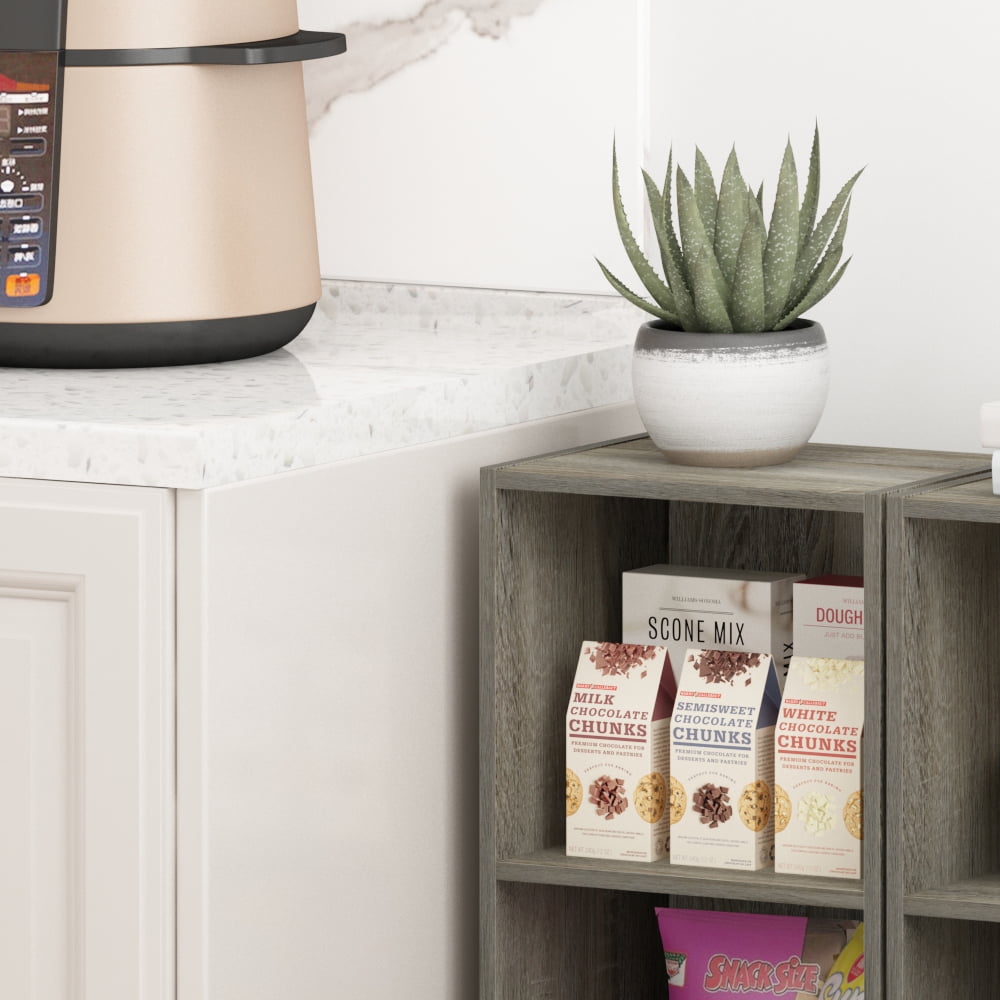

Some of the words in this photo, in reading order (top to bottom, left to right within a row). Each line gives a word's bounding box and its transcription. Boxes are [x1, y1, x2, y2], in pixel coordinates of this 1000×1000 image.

[816, 607, 863, 625] DOUGH
[648, 616, 705, 643] SCONE
[714, 621, 745, 646] MIX
[573, 692, 615, 705] MILK
[570, 706, 649, 720] CHOCOLATE
[677, 701, 756, 716] SEMISWEET
[783, 708, 837, 722] WHITE
[569, 719, 647, 737] CHUNKS
[674, 714, 753, 729] CHOCOLATE
[779, 722, 859, 736] CHOCOLATE
[673, 727, 752, 745] CHUNKS
[777, 735, 857, 753] CHUNKS
[704, 954, 774, 993] SNACK
